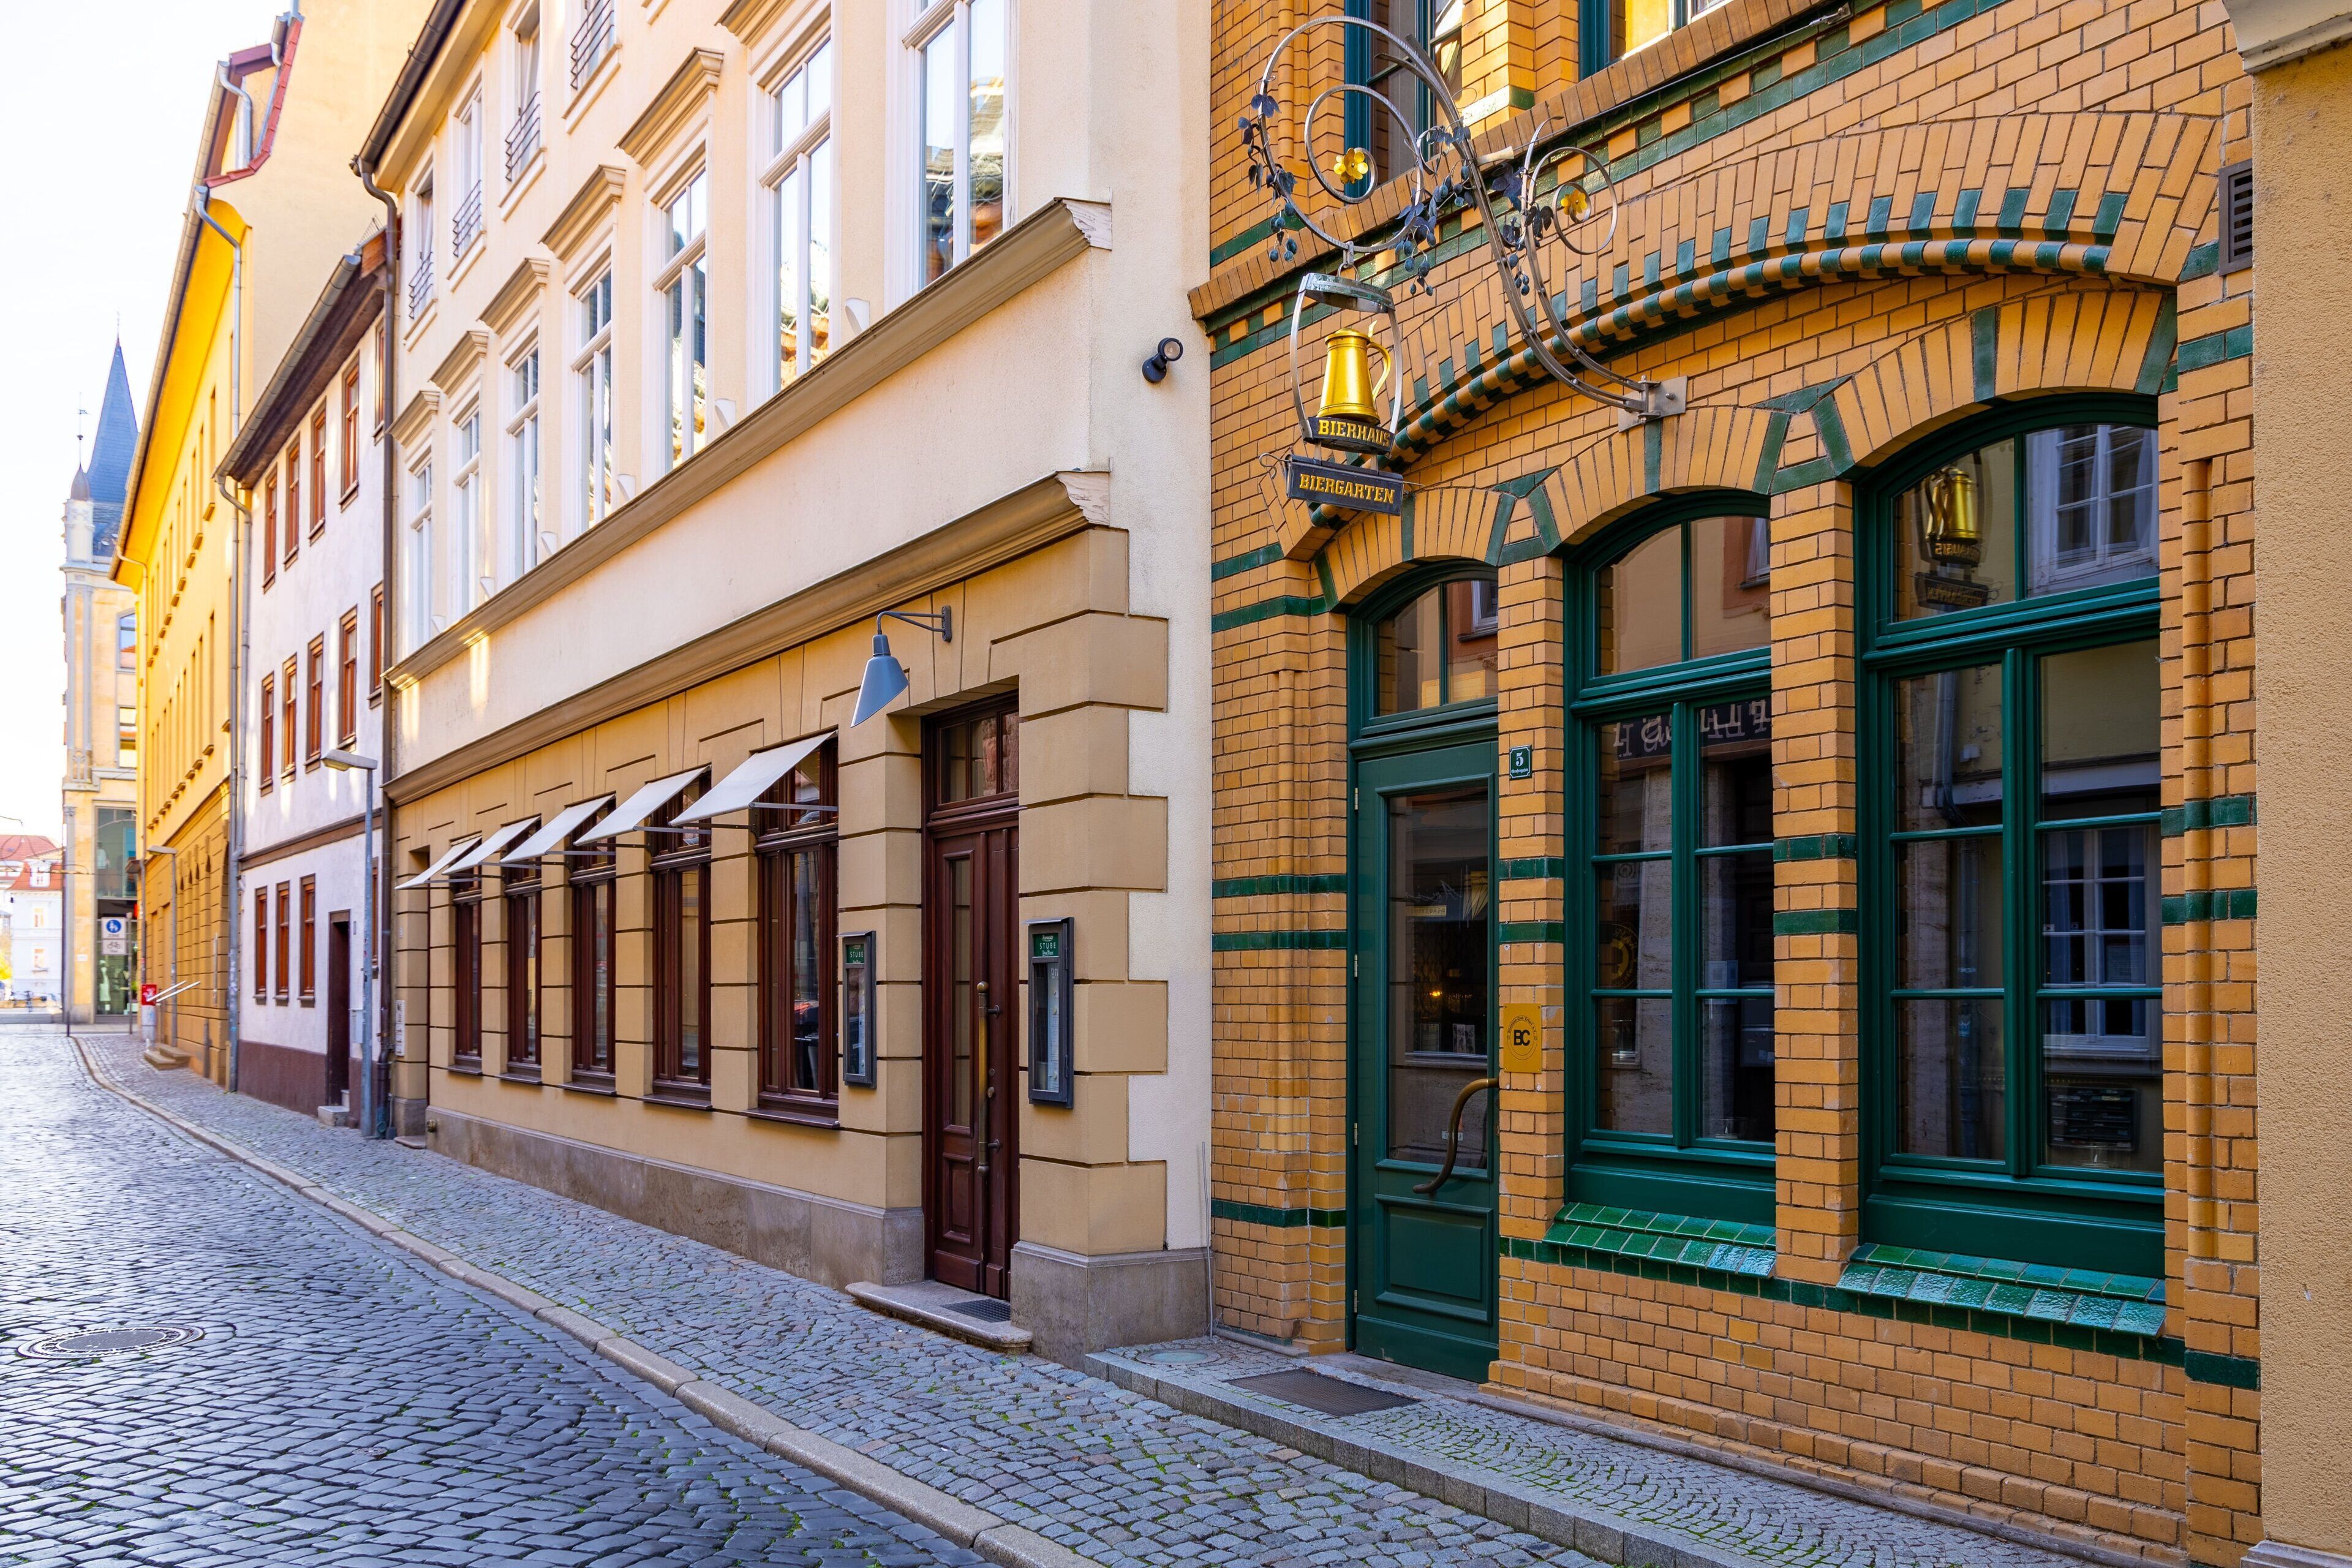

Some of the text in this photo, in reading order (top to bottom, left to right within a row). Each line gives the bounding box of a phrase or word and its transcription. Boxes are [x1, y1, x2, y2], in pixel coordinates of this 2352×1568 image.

[1318, 420, 1390, 447] BIERHAUS
[1299, 473, 1395, 504] BIERGARTEN
[1515, 751, 1524, 766] 5
[1513, 1030, 1531, 1046] BC
